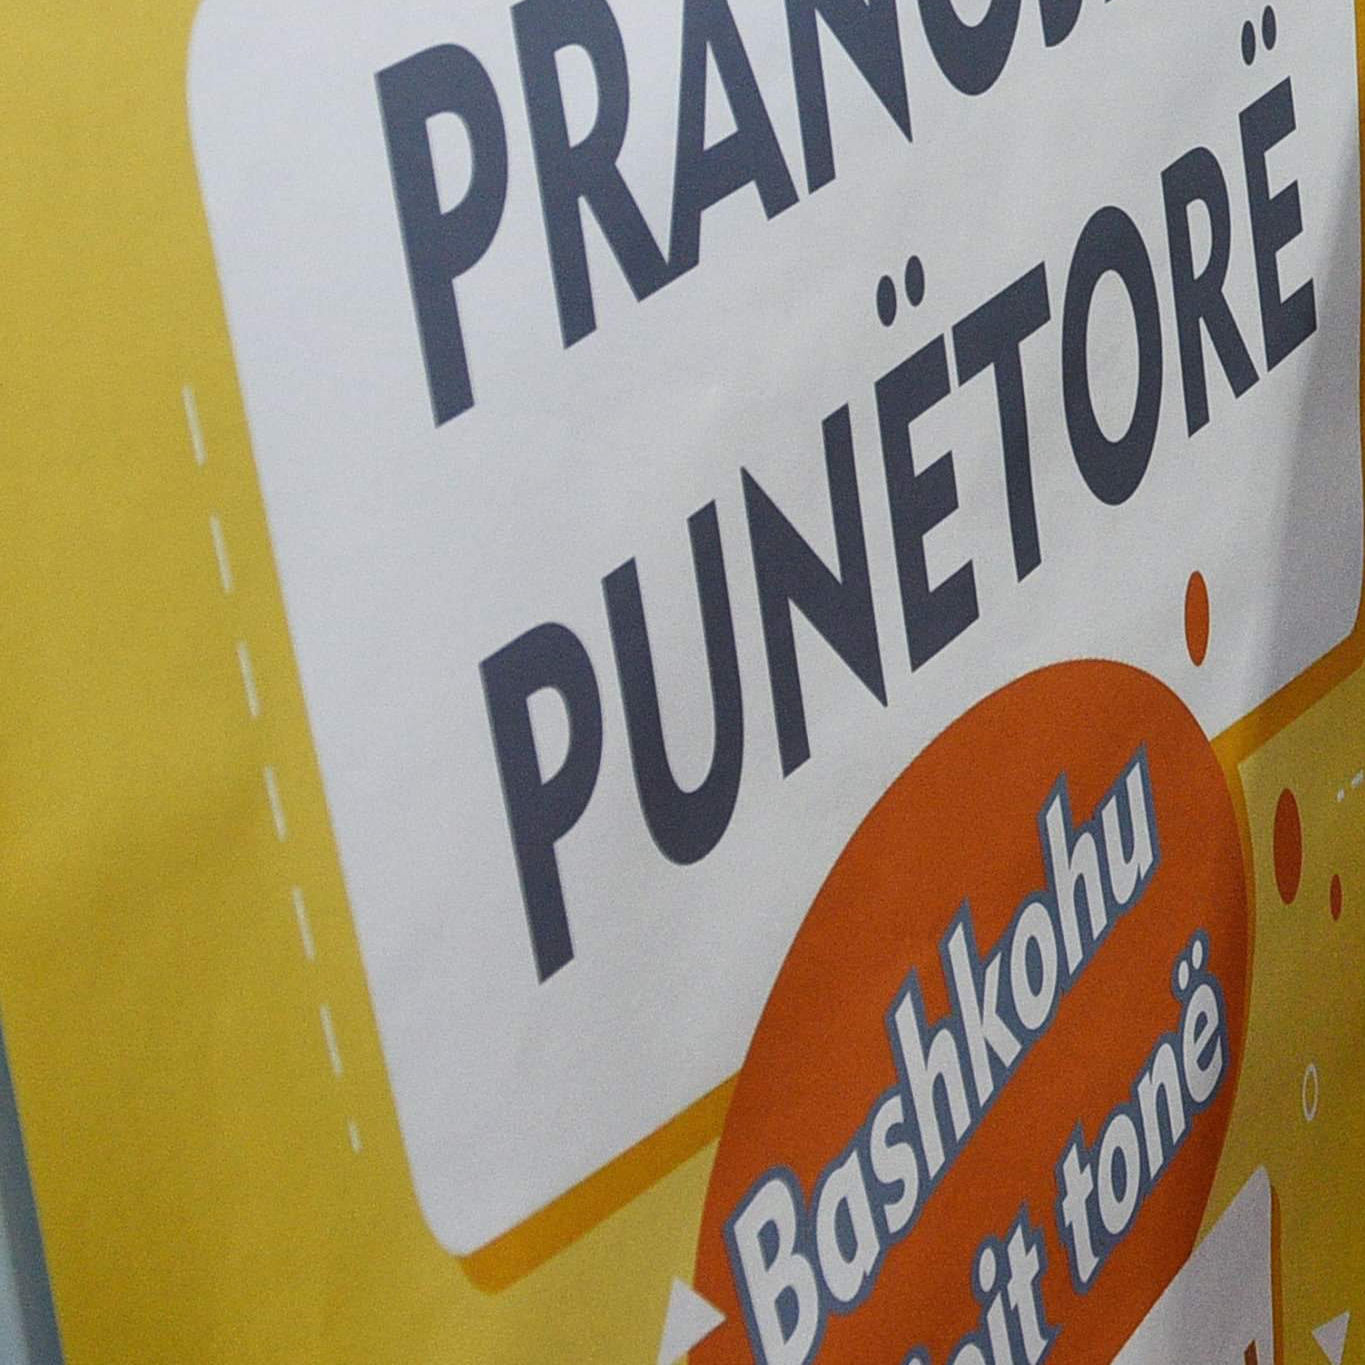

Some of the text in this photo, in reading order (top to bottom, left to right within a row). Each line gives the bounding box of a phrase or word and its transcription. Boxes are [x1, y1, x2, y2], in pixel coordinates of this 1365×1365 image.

[477, 4, 1319, 984] PUNËTORË
[726, 743, 1160, 1365] Bashkohu
[1055, 930, 1229, 1293] tonë
